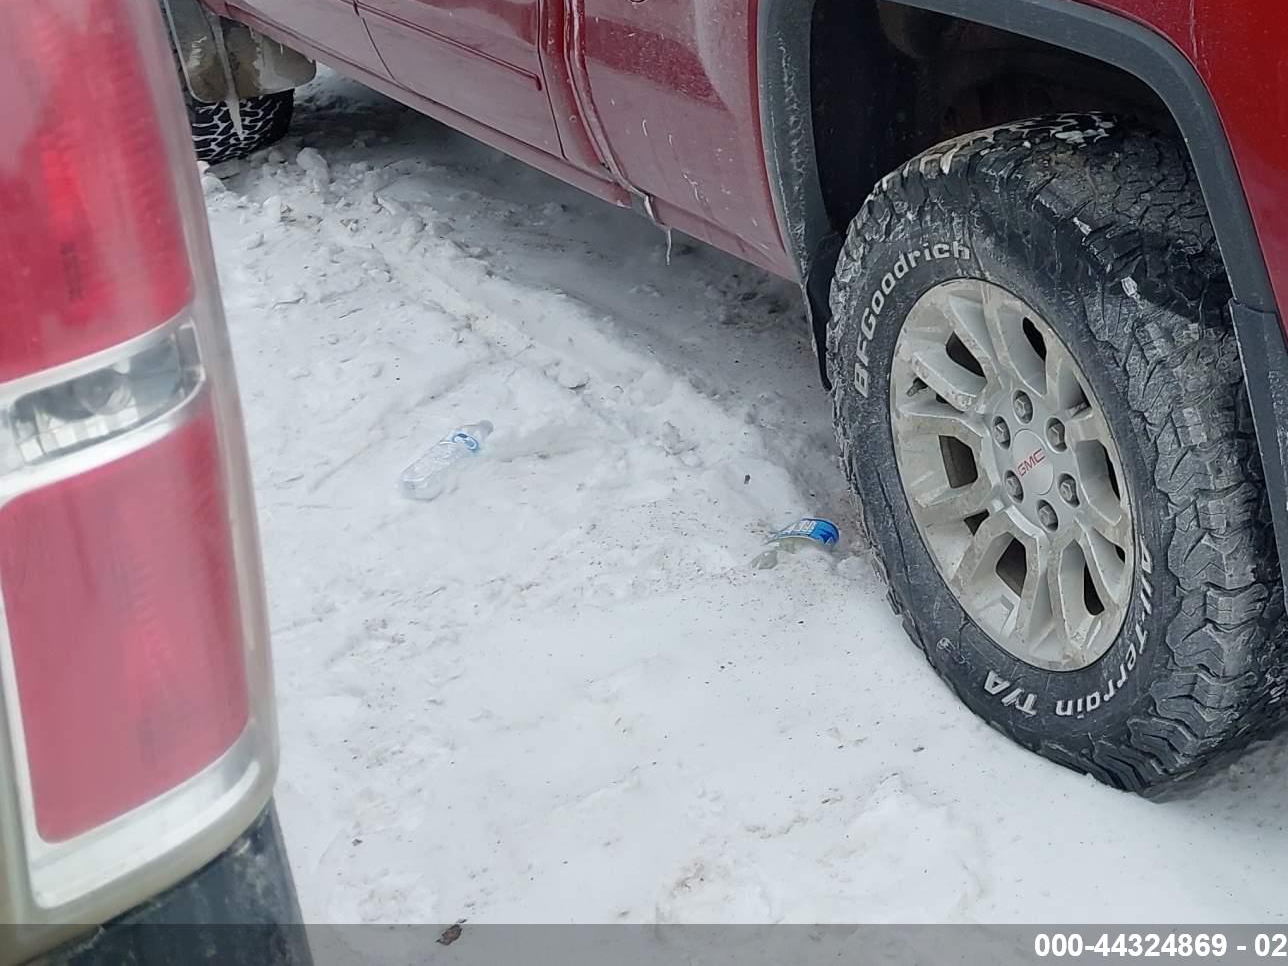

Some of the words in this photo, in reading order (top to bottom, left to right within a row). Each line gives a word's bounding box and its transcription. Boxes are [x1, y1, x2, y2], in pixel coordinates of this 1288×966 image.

[855, 241, 970, 398] BFGoodrich
[1017, 448, 1046, 477] GMC
[984, 670, 1037, 716] T/A
